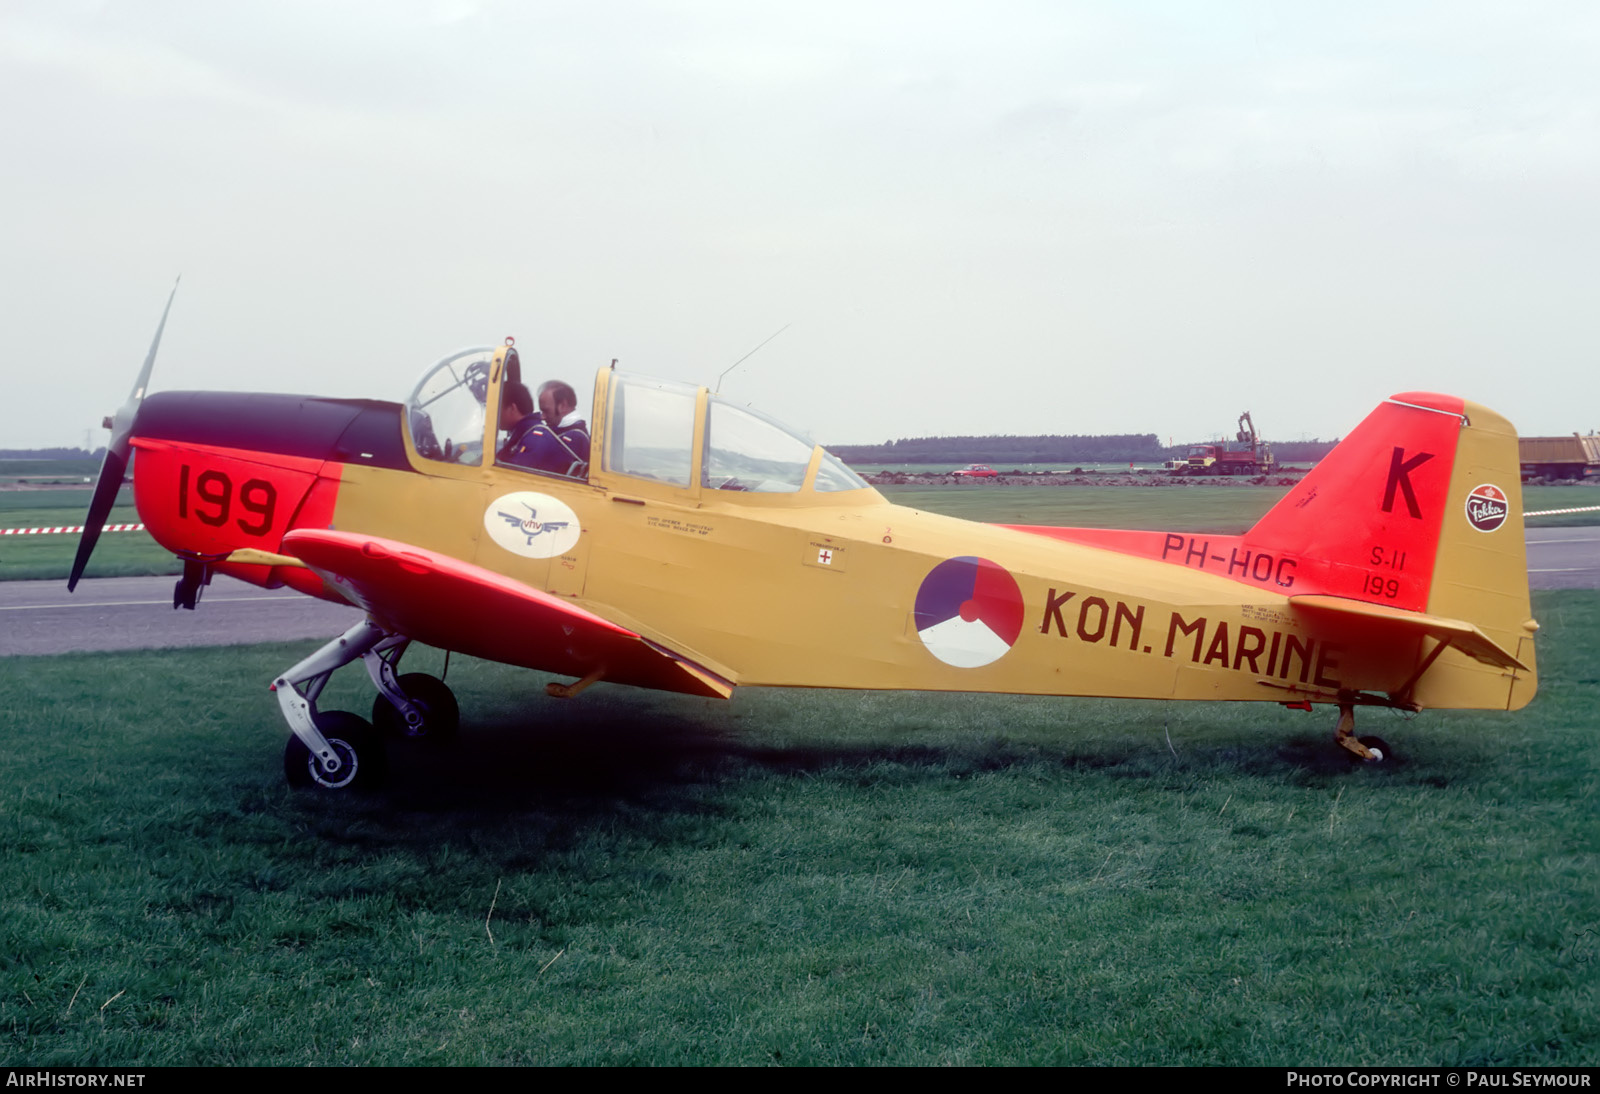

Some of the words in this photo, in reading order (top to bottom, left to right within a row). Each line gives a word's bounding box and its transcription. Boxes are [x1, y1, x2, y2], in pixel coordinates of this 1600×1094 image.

[178, 463, 278, 537] 199
[1381, 446, 1436, 520] K
[1162, 533, 1298, 588] PH-HOG
[1363, 574, 1399, 599] 199
[1040, 587, 1153, 655] KON.
[1163, 611, 1343, 690] MARINE
